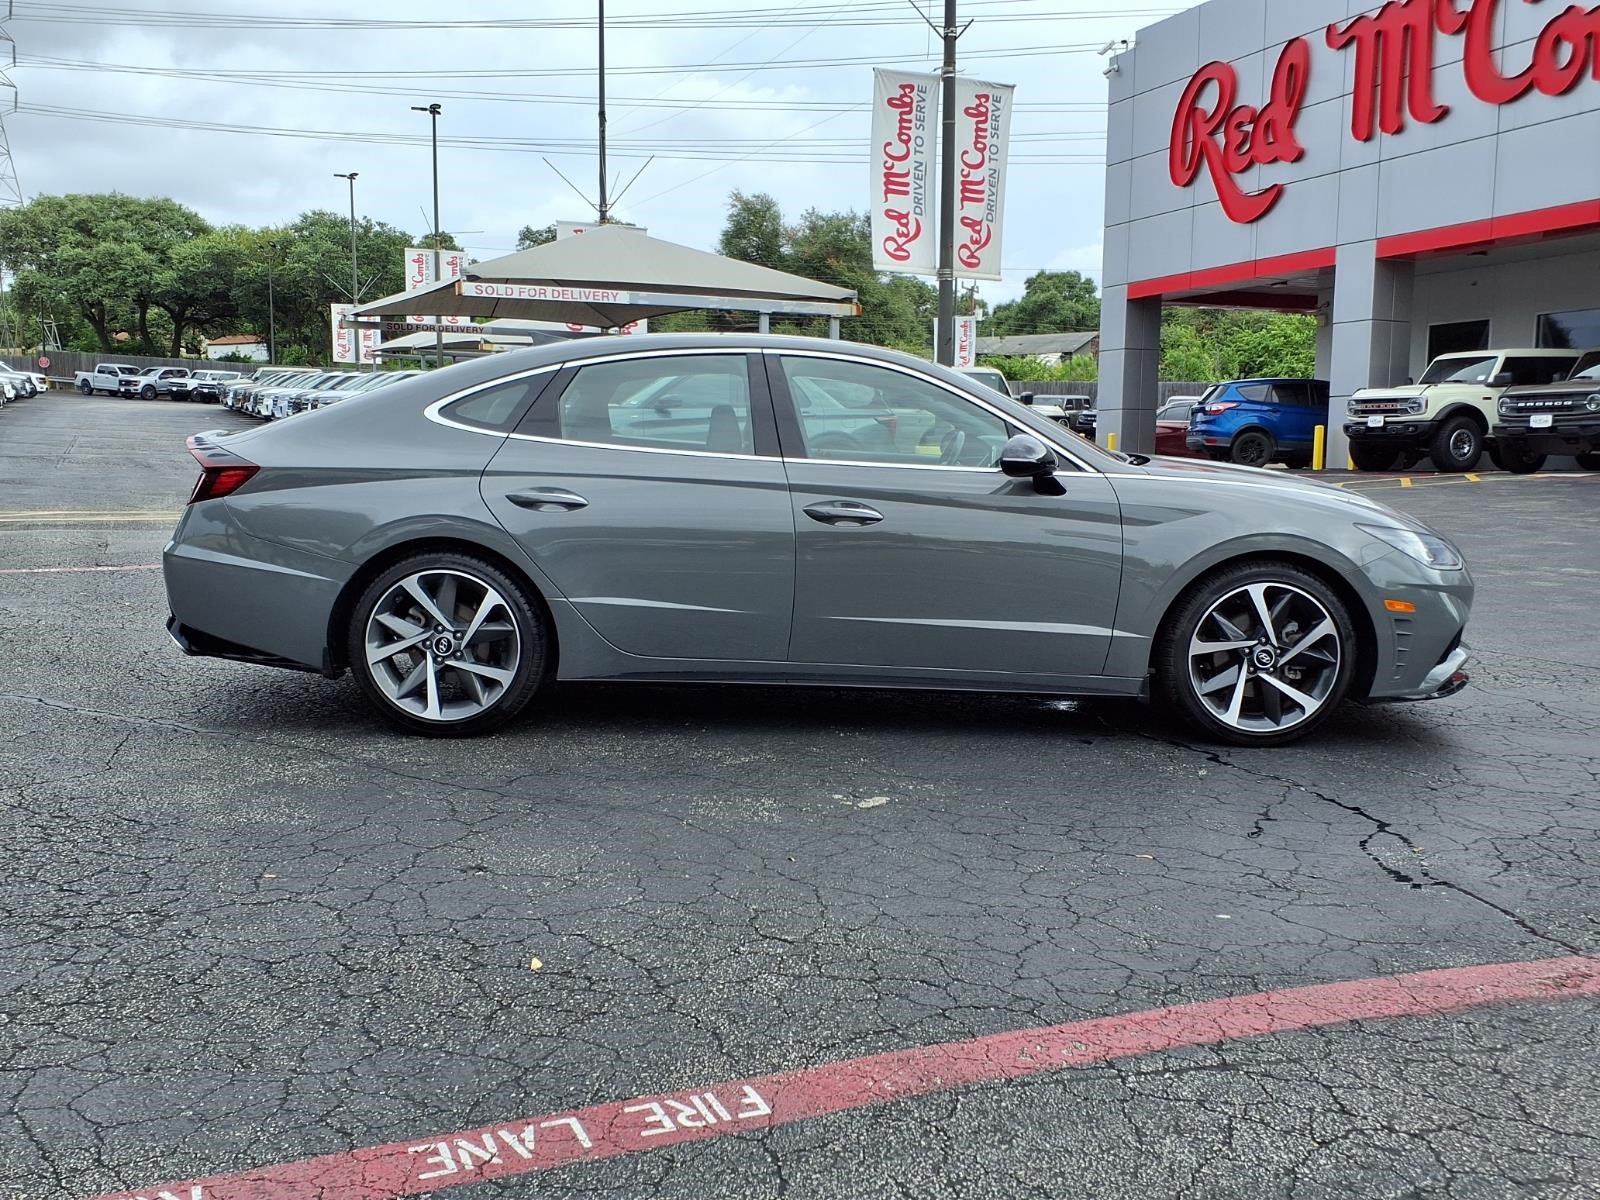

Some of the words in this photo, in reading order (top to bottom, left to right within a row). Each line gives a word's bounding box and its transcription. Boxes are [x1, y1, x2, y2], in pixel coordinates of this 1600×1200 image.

[915, 83, 927, 132] SERVE
[990, 94, 1002, 139] SERVE
[1169, 37, 1311, 224] Red
[1325, 0, 1600, 143] McCo
[883, 84, 915, 204] McCombs
[914, 135, 925, 156] TO
[960, 93, 990, 211] McCombs
[988, 143, 1000, 163] TO
[913, 160, 924, 217] DRIVEN
[985, 168, 998, 223] DRIVEN
[883, 208, 922, 262] Red
[958, 215, 992, 269] Red
[474, 284, 514, 297] SOLD
[518, 287, 548, 298] FOR
[551, 289, 619, 302] DELIVERY
[386, 322, 413, 331] SOLD
[416, 324, 436, 332] FOR
[438, 325, 484, 334] DELIVERY
[623, 1085, 773, 1137] FIRE
[407, 1116, 593, 1181] LANE
